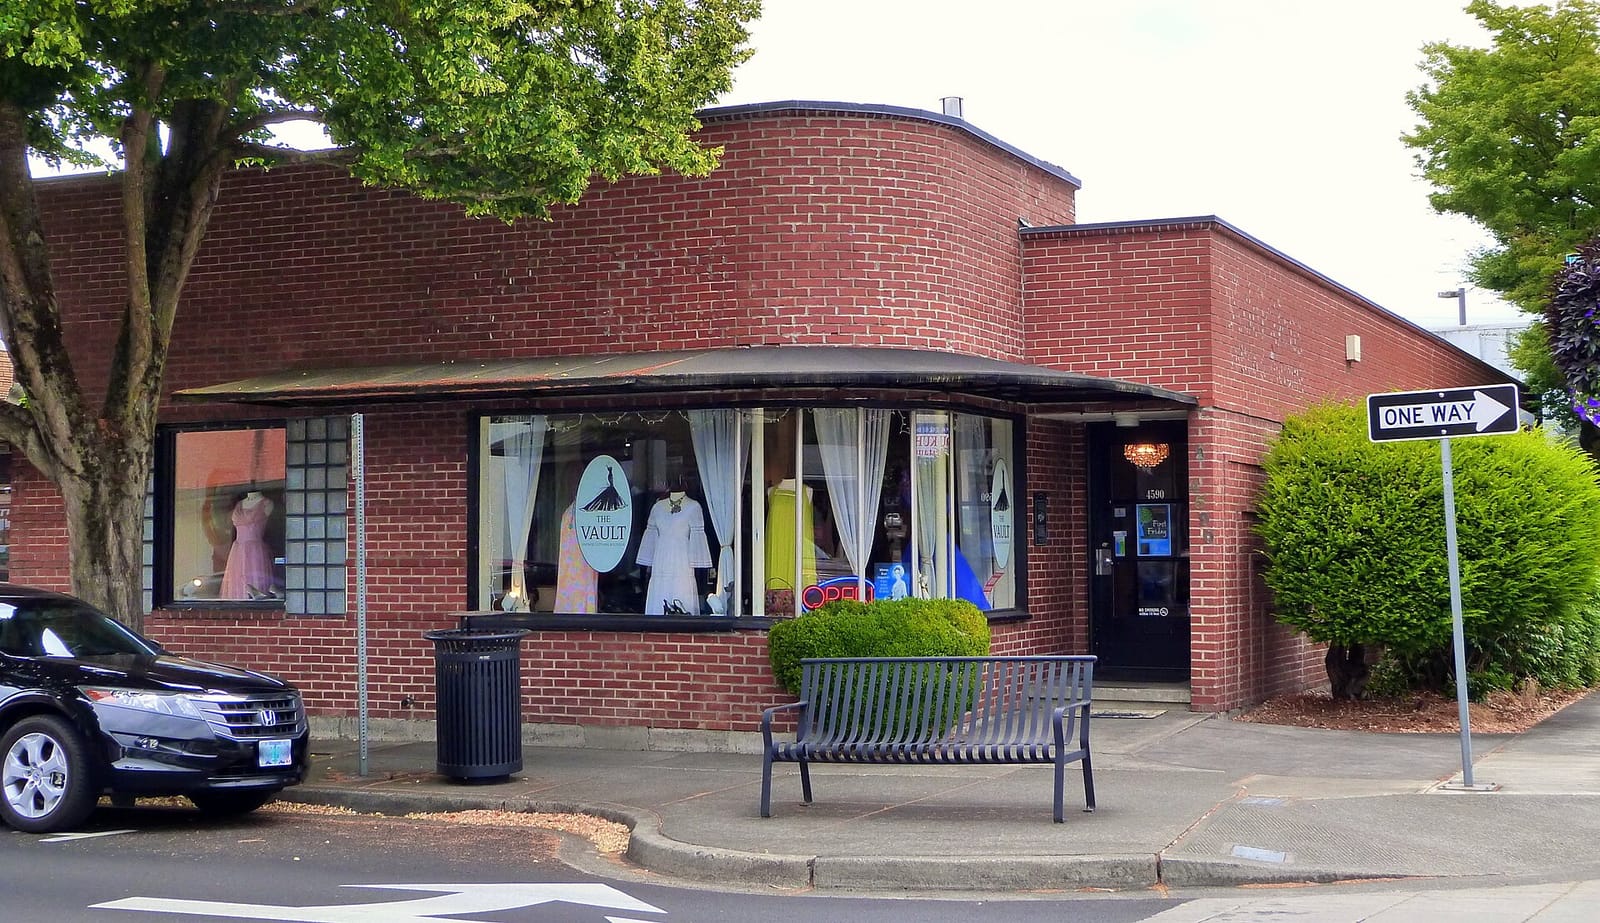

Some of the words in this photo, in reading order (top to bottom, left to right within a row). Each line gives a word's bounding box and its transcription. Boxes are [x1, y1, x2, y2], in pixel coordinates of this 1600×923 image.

[1385, 407, 1424, 425] ONE
[1432, 403, 1475, 422] WAY
[1146, 489, 1165, 500] 4590
[596, 515, 611, 523] THE
[1152, 519, 1167, 528] First
[580, 525, 627, 540] VAULT
[993, 525, 1010, 539] VAULT
[1147, 527, 1167, 538] Friday
